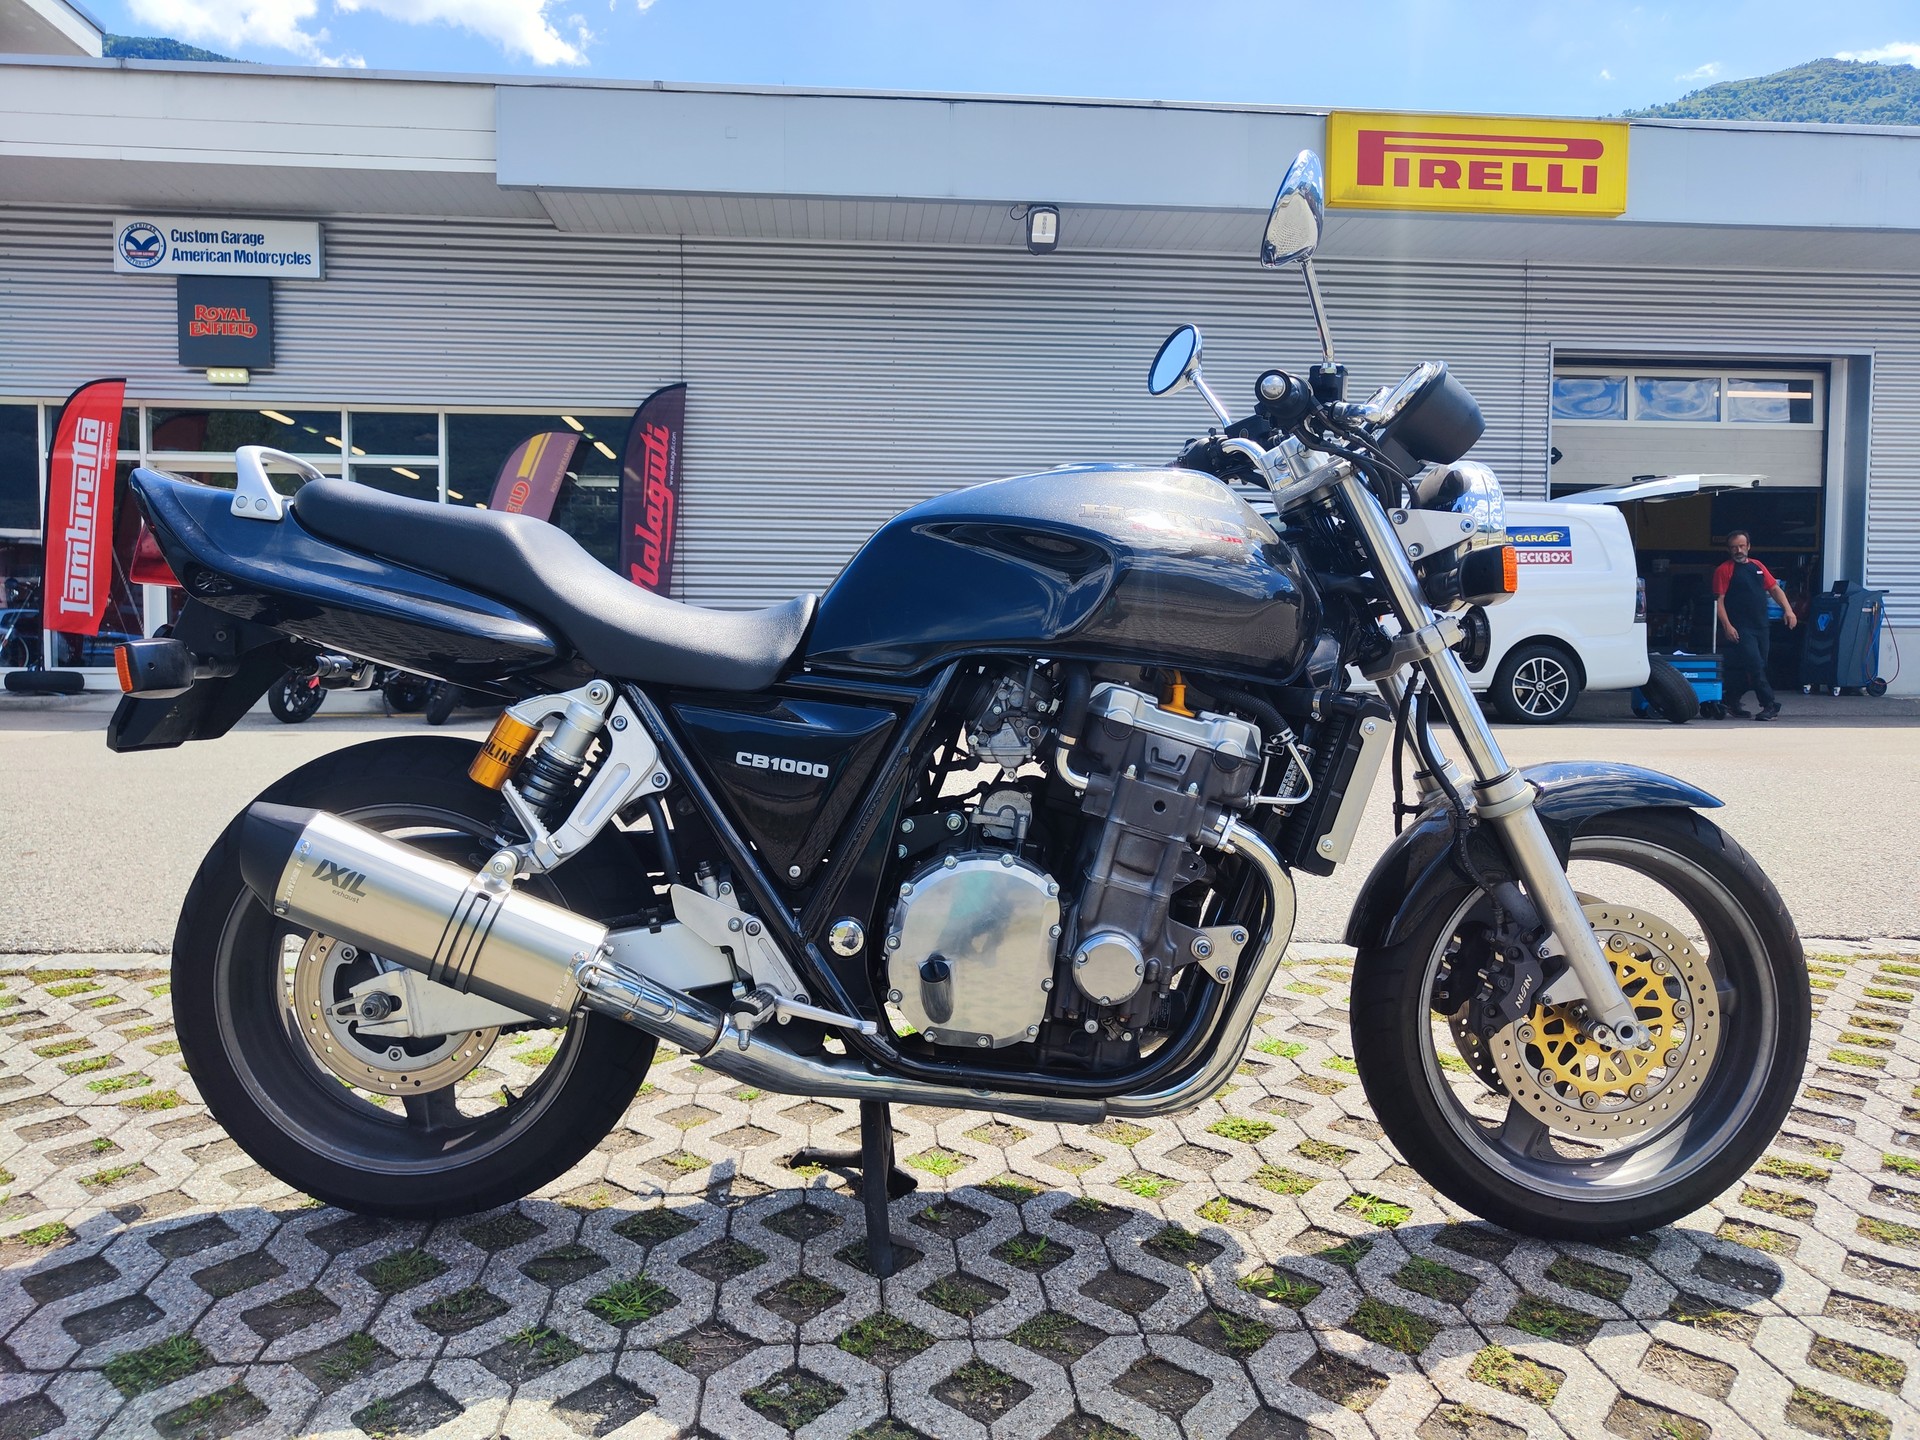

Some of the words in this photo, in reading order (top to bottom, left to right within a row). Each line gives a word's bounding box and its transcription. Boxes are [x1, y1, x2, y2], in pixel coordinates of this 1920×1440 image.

[1357, 130, 1604, 194] PIRELLI
[170, 229, 219, 244] Custom
[221, 231, 264, 246] Garage
[171, 248, 231, 263] American
[233, 249, 312, 266] Motorcycles
[194, 304, 250, 322] ROYAL
[189, 321, 258, 338] ENFIELD
[103, 422, 113, 471] lambretta.com
[669, 431, 677, 485] www.malaguti.com
[1515, 534, 1560, 543] GARAGE
[736, 752, 829, 778] CB1000
[312, 859, 366, 897] IXIL
[332, 890, 359, 903] exhaust
